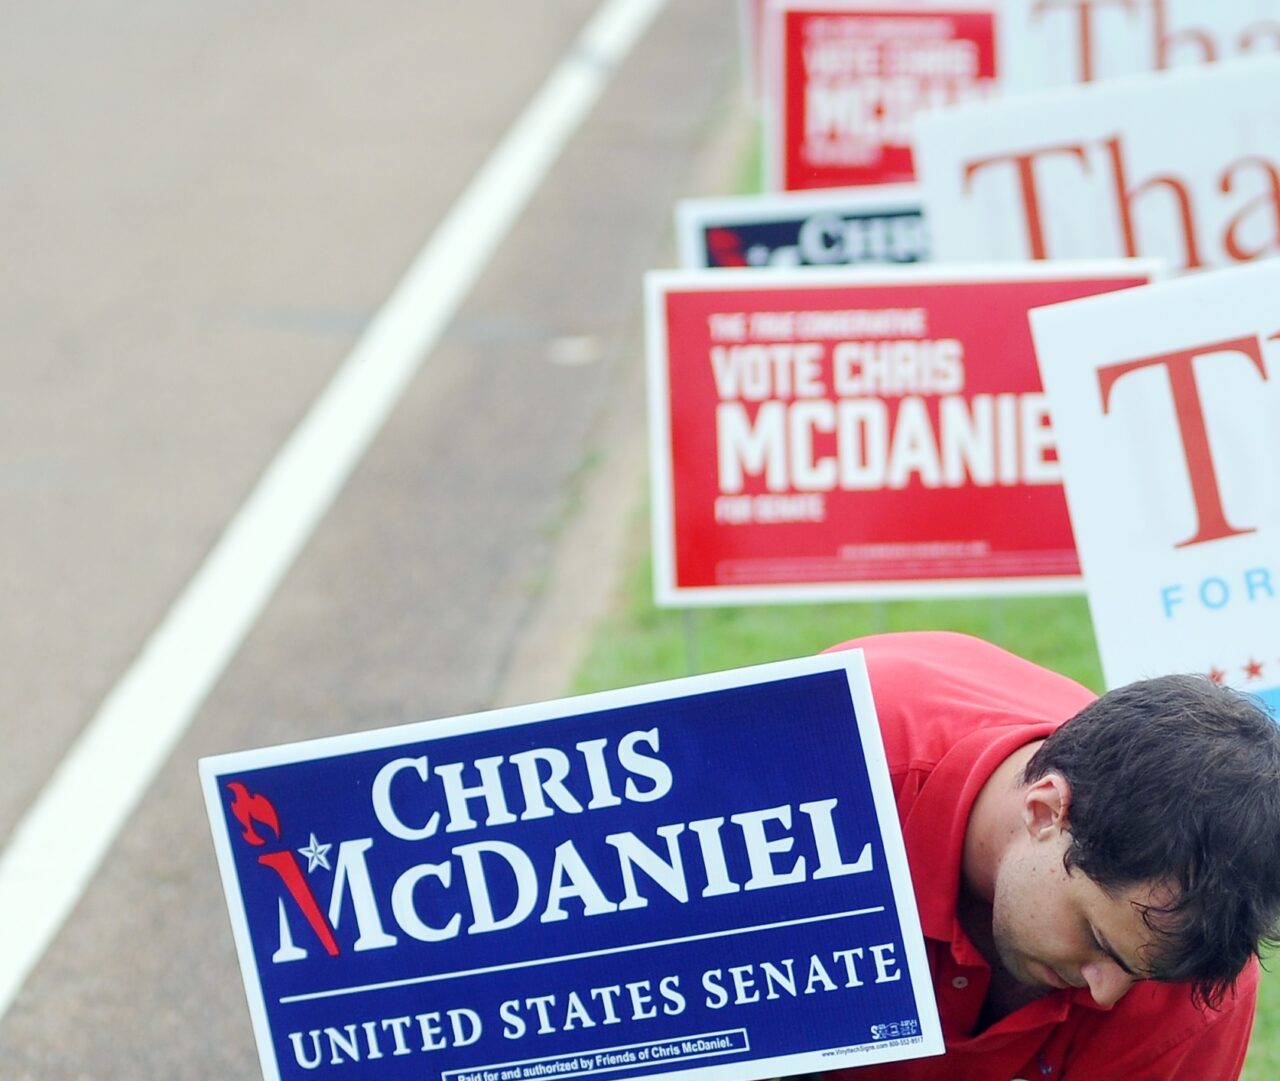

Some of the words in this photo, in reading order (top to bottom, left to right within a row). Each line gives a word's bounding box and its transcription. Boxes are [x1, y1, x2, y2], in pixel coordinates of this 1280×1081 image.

[710, 344, 826, 400] VOTE
[833, 338, 964, 397] CHRIS
[716, 393, 1064, 494] MCDANIE
[1160, 568, 1277, 618] FOR
[371, 727, 674, 841] CHRIS
[258, 797, 874, 964] MCDANIEL
[288, 1008, 483, 1070] UNITED
[500, 975, 688, 1040] STATES
[701, 942, 902, 1010] SENATE
[501, 1067, 522, 1081] and
[523, 1058, 579, 1078] authorized
[579, 1057, 595, 1071] by
[595, 1048, 637, 1067] Friends
[638, 1050, 650, 1061] of
[651, 1043, 681, 1059] Chris
[681, 1036, 734, 1055] McDaniel.
